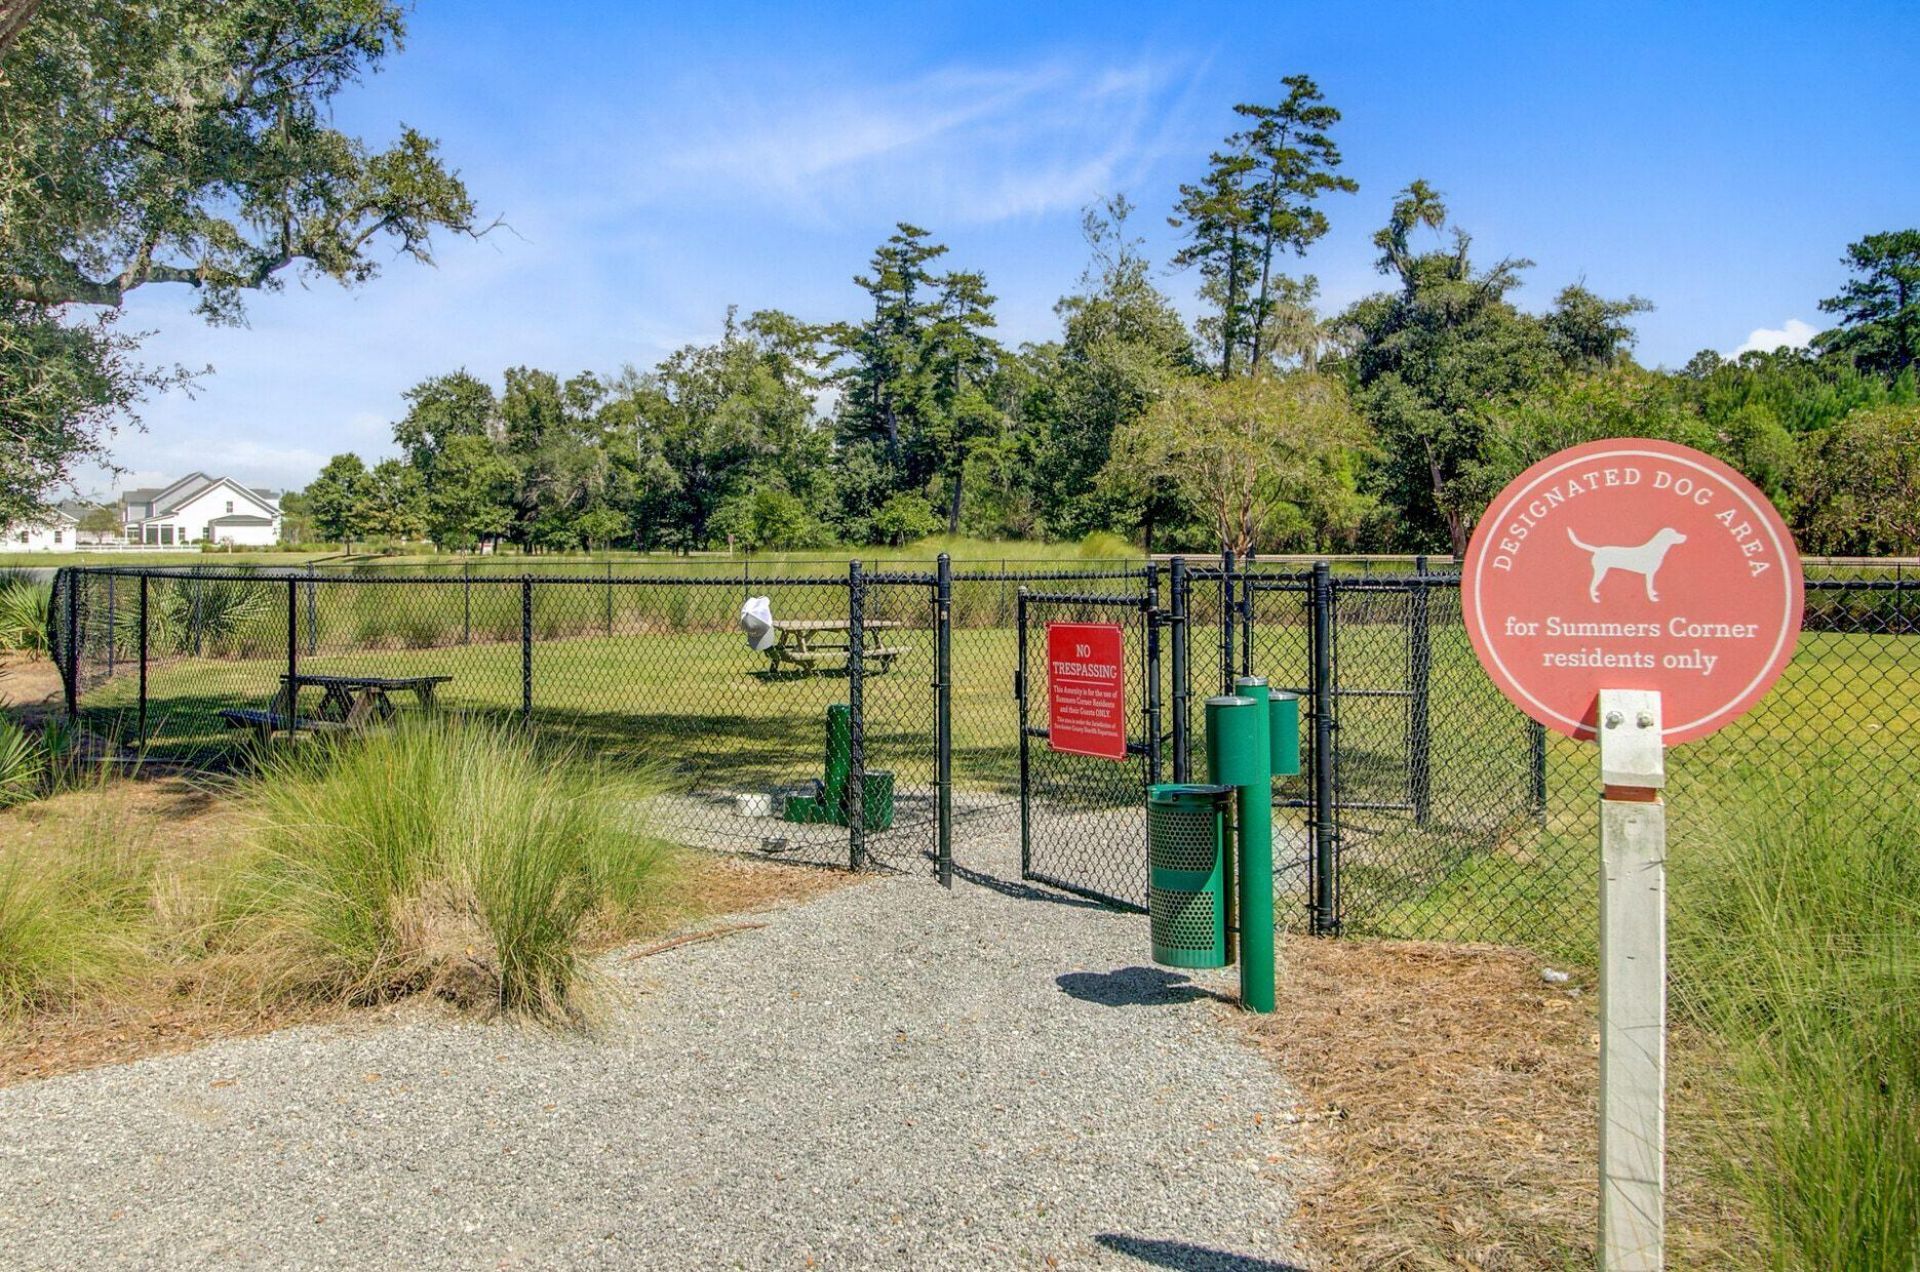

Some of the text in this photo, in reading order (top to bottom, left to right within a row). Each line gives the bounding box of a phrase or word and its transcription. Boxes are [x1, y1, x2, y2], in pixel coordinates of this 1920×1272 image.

[1493, 467, 1771, 577] DESIGNATED DOG AREA
[1505, 616, 1759, 638] for Summers Corner
[1076, 644, 1090, 657] NO
[1053, 662, 1117, 679] TRESPASSING
[1542, 649, 1718, 675] residents only
